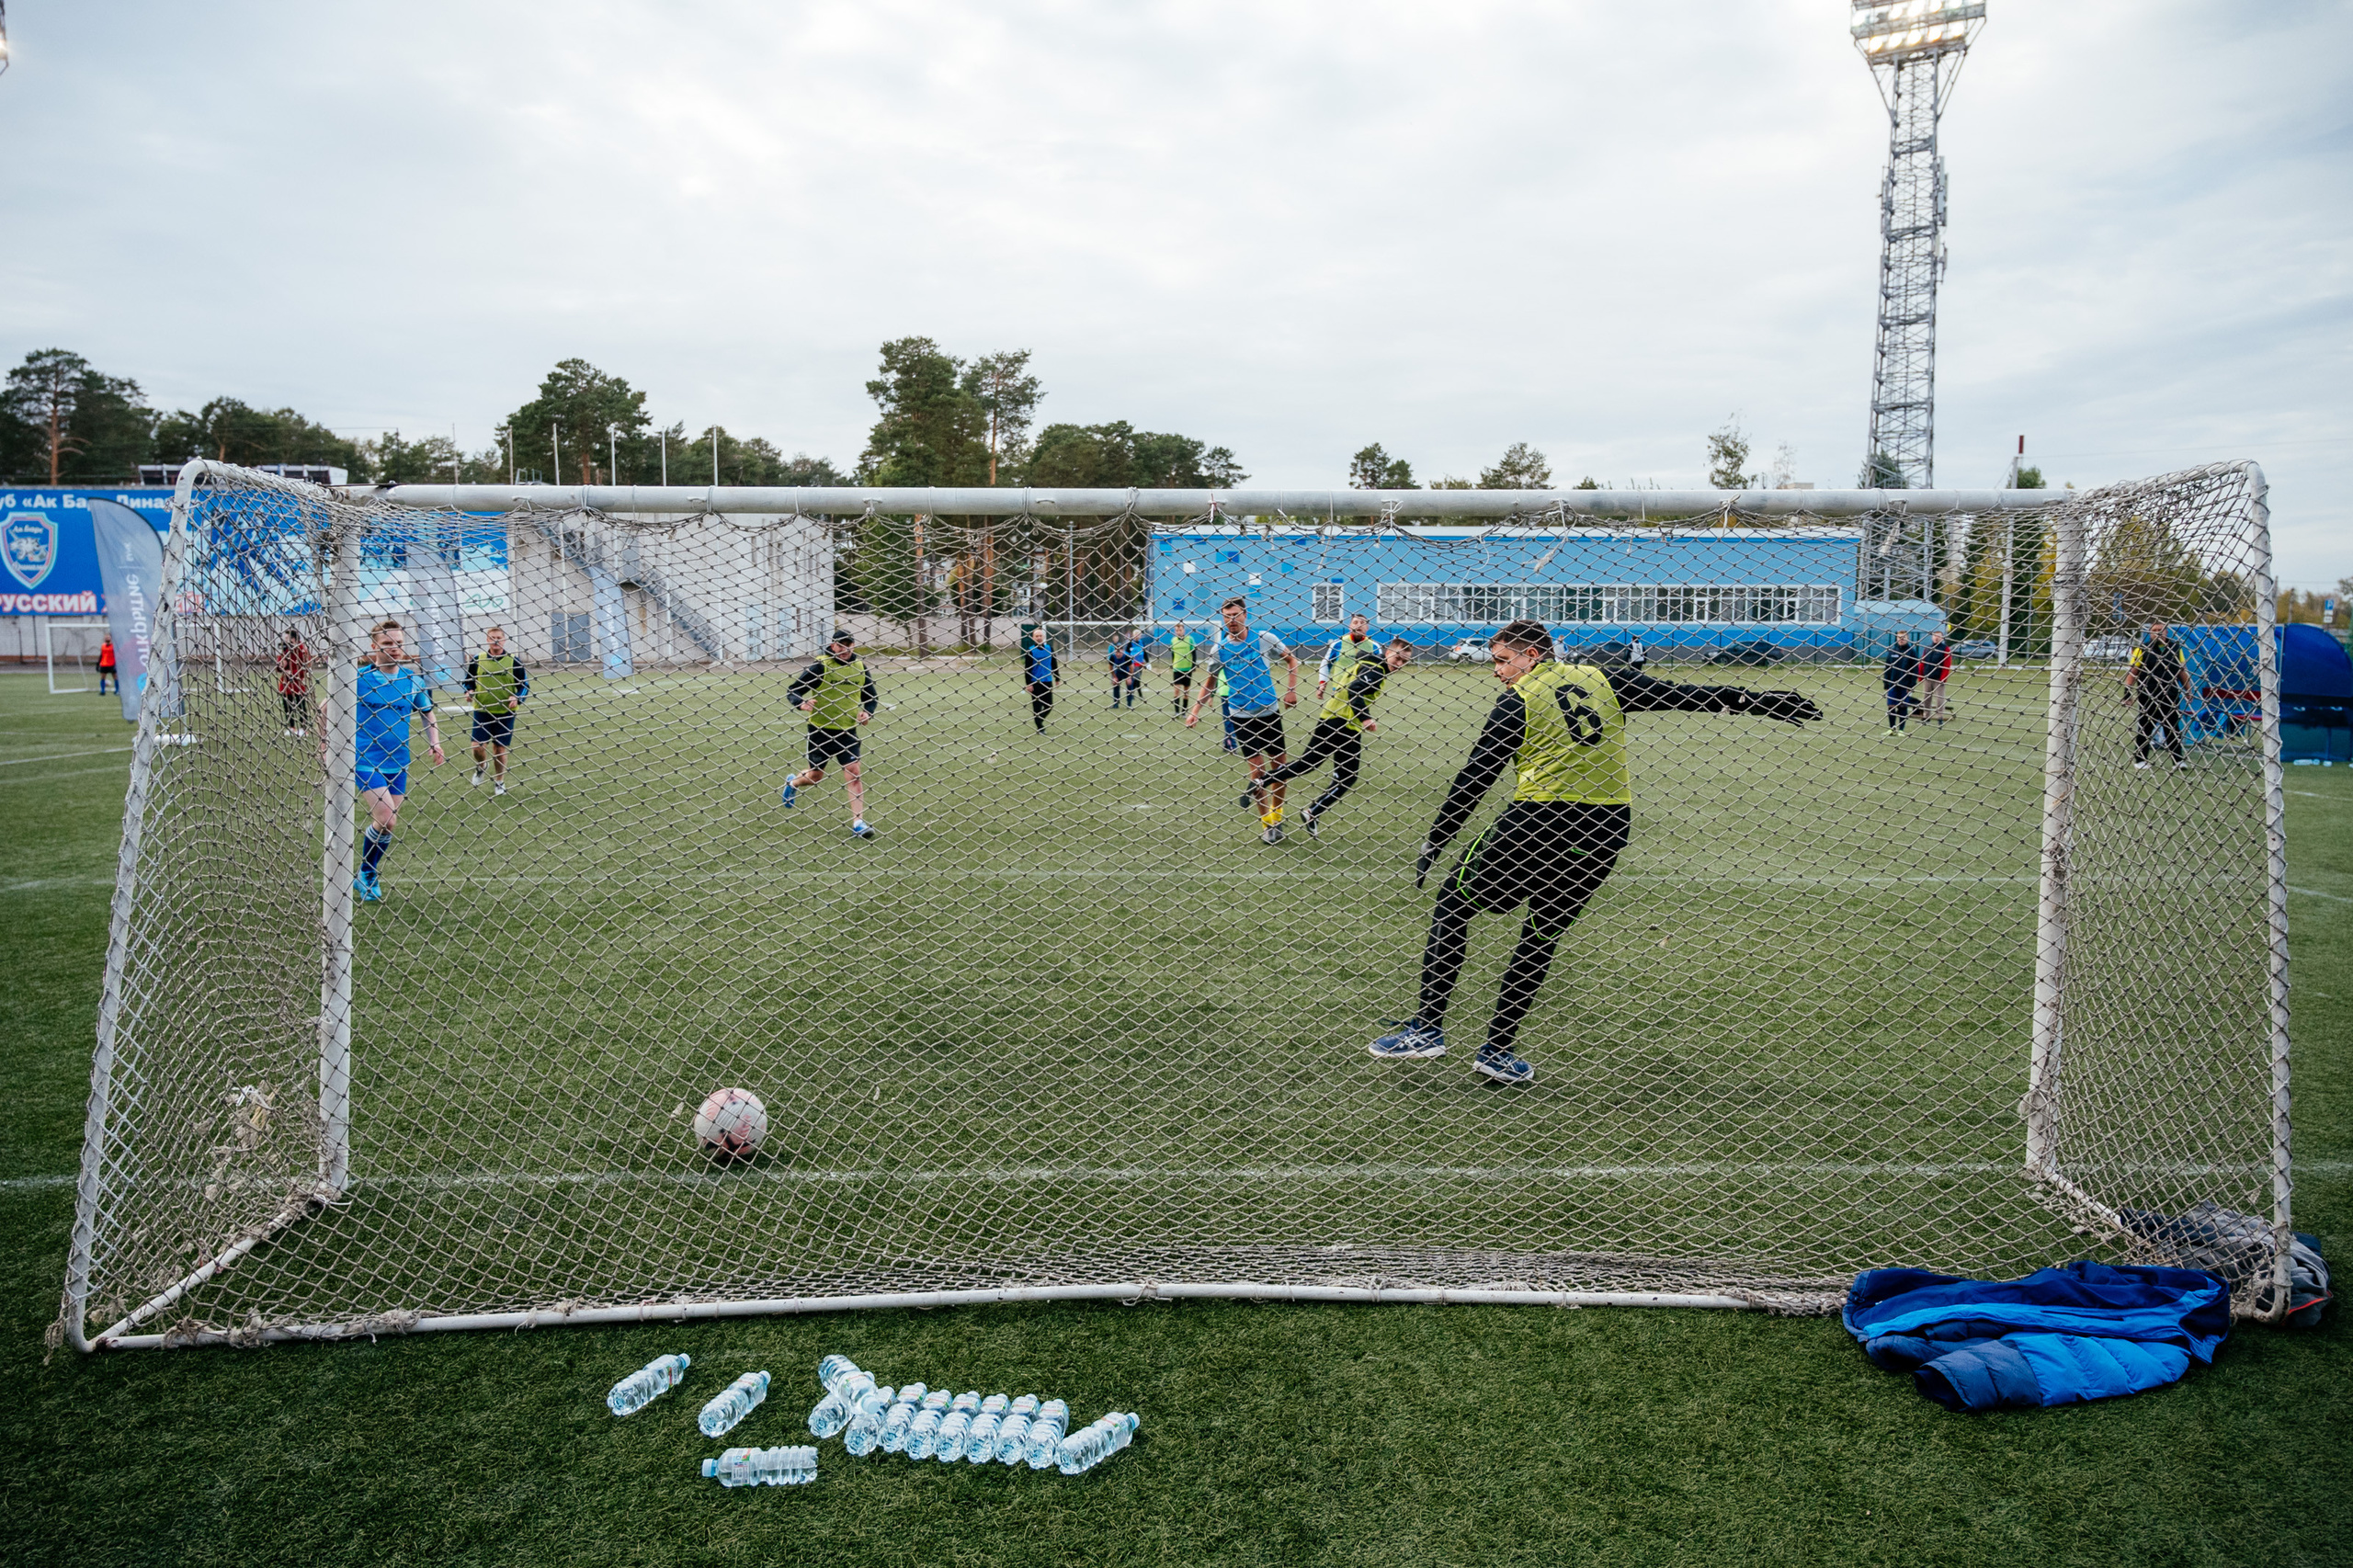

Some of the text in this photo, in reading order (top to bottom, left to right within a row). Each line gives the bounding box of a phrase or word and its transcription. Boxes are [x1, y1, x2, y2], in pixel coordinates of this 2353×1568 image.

[22, 494, 57, 508] «Ак
[63, 494, 91, 512] Ба
[0, 590, 97, 613] УССКИЙ
[1554, 684, 1604, 747] 6
